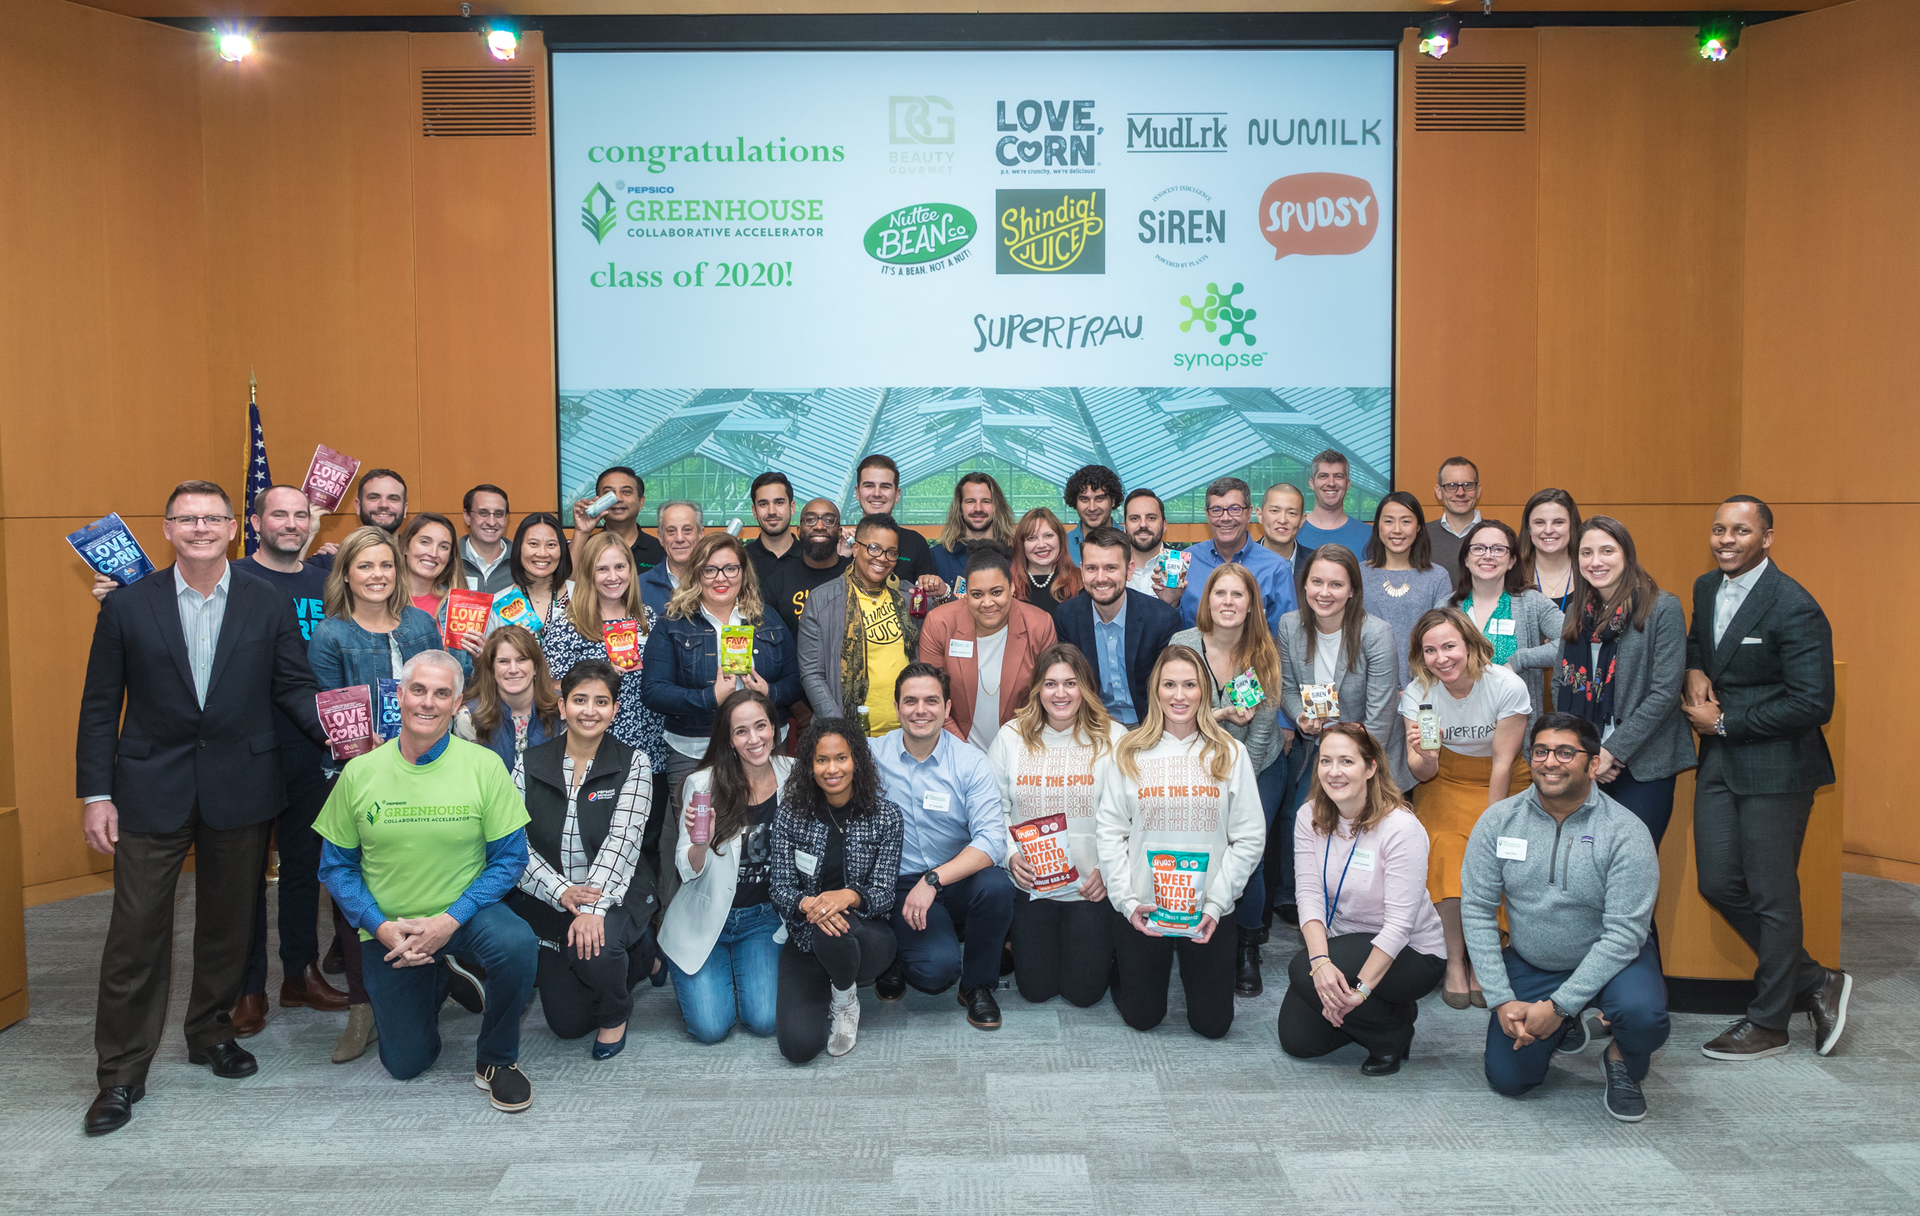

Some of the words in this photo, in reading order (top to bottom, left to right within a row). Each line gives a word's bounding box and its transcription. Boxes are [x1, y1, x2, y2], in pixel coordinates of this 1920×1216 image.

[996, 99, 1104, 135] LOVE,
[1127, 117, 1228, 148] MudLrk
[1248, 118, 1382, 146] NUMILK
[587, 136, 845, 174] congratulations
[889, 151, 955, 163] BEAUTY
[995, 135, 1095, 166] CORN
[889, 166, 954, 174] GOURMET
[627, 186, 675, 194] PEPSICO
[1152, 186, 1179, 202] INNOCENT
[1179, 185, 1212, 202] INDULGENCE
[626, 199, 824, 221] GREENHOUSE
[889, 206, 940, 228] Nuttee
[1266, 195, 1372, 232] SPUDSY
[1001, 191, 1097, 246] Shindig!
[627, 228, 731, 237] COLLABORATIVE
[735, 227, 824, 237] ACCELERATOR
[876, 213, 954, 259] BEAN
[1019, 227, 1080, 266] JUICE
[881, 265, 896, 275] IT'S
[898, 267, 904, 276] A
[929, 261, 946, 272] NOT
[948, 258, 954, 267] A
[953, 248, 972, 264] NUT!
[1154, 254, 1180, 268] POWERED
[1189, 254, 1209, 267] PLANTS
[590, 262, 663, 287] class
[673, 261, 709, 287] of
[714, 261, 793, 287] 2020!
[1173, 352, 1264, 371] synapse
[309, 475, 344, 496] CORN
[98, 545, 141, 573] CORN
[501, 599, 524, 617] FAVA
[610, 632, 633, 643] FAVA
[725, 636, 749, 645] FAVA
[324, 706, 371, 728] LOVE,
[329, 721, 370, 742] CORN
[1048, 747, 1067, 757] THE
[1047, 756, 1066, 766] THE
[1138, 757, 1165, 769] SAVE
[1167, 756, 1188, 767] THE
[1017, 765, 1043, 776] SAVE
[1046, 766, 1065, 776] THE
[1139, 767, 1165, 778] SAVE
[1168, 766, 1189, 777] THE
[1016, 775, 1042, 787] SAVE
[1045, 776, 1064, 787] THE
[1067, 775, 1094, 786] SPUD
[1138, 776, 1165, 789] SAVE
[1168, 776, 1189, 786] THE
[1015, 786, 1042, 797] SAVE
[1044, 787, 1065, 797] THE
[1067, 786, 1095, 796] SPUD
[1138, 785, 1165, 799] SAVE
[1168, 785, 1189, 797] THE
[1191, 785, 1220, 798] SPUD
[1016, 796, 1042, 807] SAVE
[1044, 797, 1065, 807] THE
[1067, 796, 1095, 806] SPUD
[1138, 797, 1166, 809] SAVE
[1168, 797, 1189, 808] THE
[1191, 796, 1220, 809] SPUD
[384, 805, 470, 818] GREENHOUSE
[1067, 806, 1095, 817] SPUD
[1139, 808, 1166, 820] SAVE
[1168, 808, 1189, 820] THE
[1191, 808, 1219, 820] SPUD
[1139, 819, 1166, 832] SAVE
[1168, 819, 1189, 831] THE
[1191, 819, 1218, 832] SPUD
[1018, 828, 1038, 840] SPUDSY
[1021, 837, 1057, 855] SWEET
[1024, 847, 1065, 865] POTATO
[1154, 859, 1175, 867] SPUDSY
[1034, 861, 1060, 876] UFFS
[1153, 872, 1192, 886] SWEET
[1154, 884, 1196, 899] POTATO
[1155, 895, 1187, 911] PUFFS
